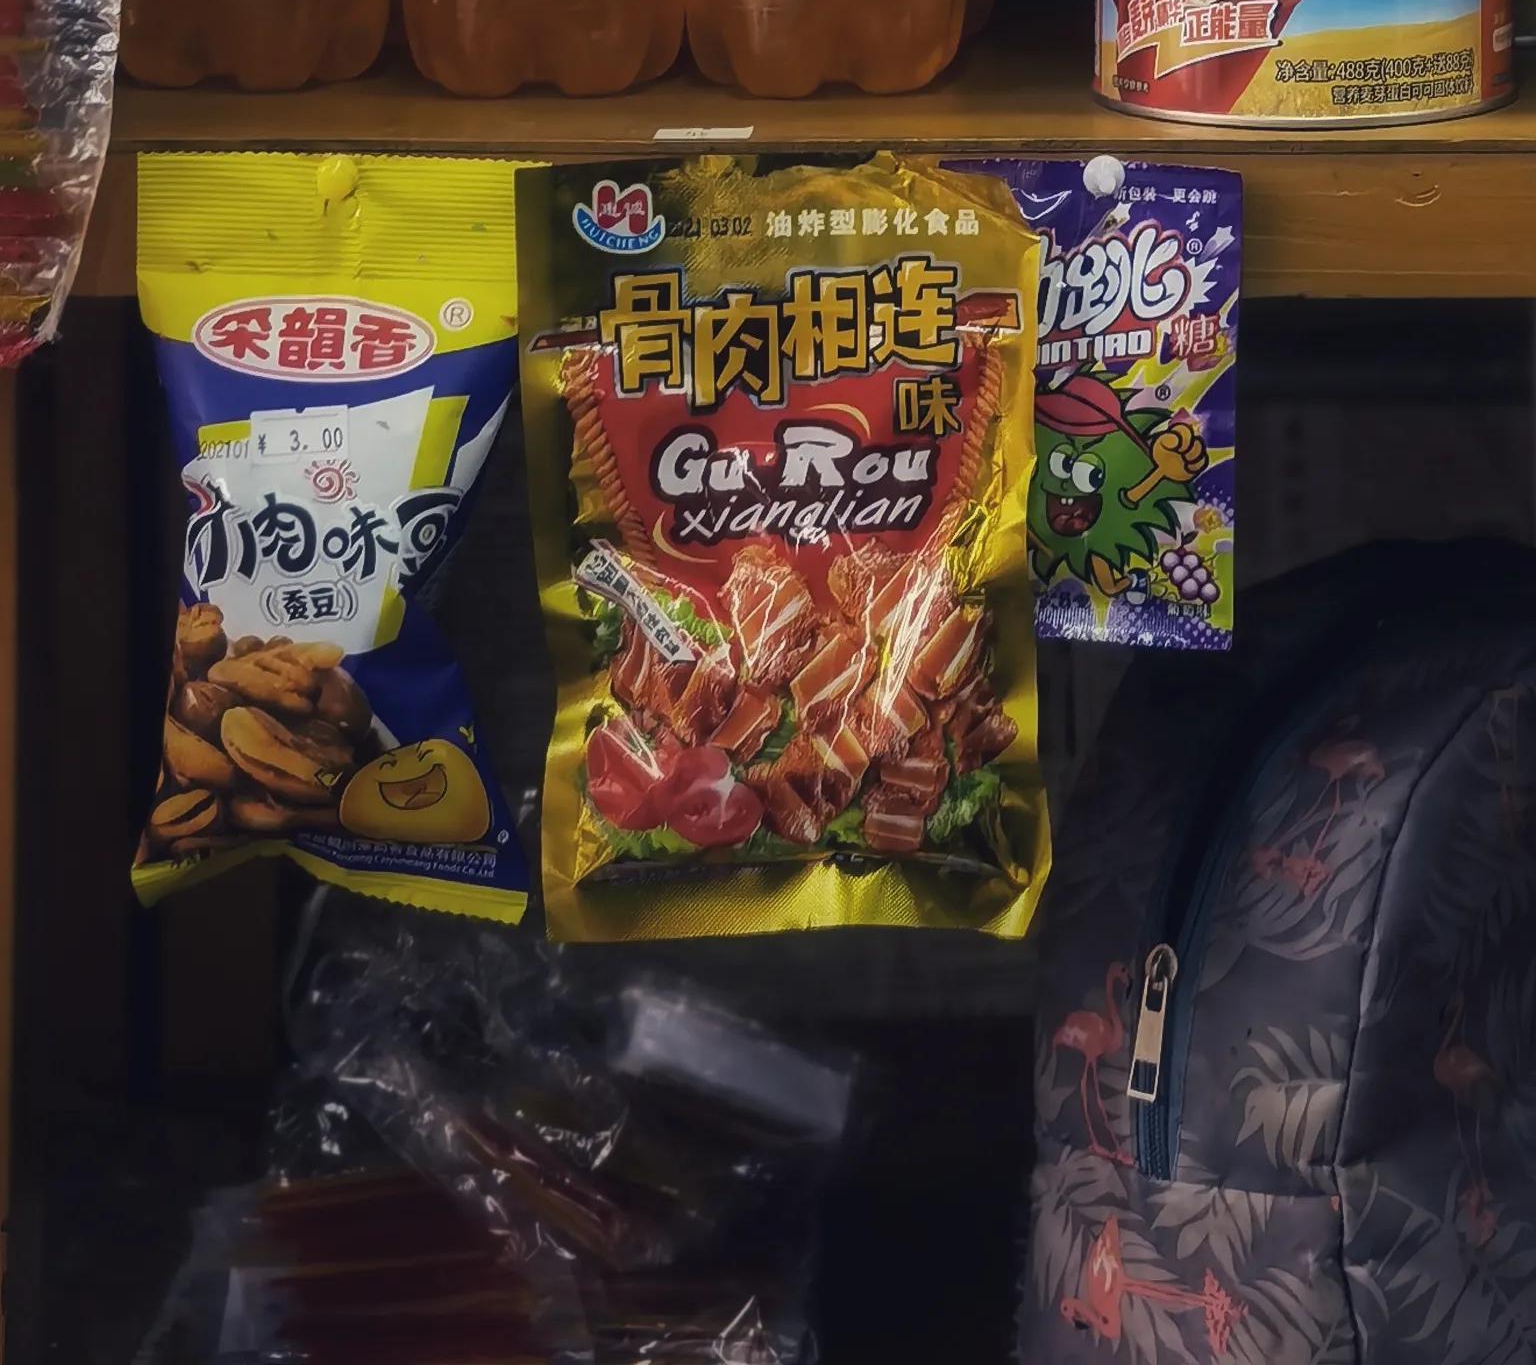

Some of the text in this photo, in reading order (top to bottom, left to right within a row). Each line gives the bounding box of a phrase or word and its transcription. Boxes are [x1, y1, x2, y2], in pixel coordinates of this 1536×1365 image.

[1184, 1, 1273, 44] 正能量
[765, 209, 979, 237] 油炸型膨化食品
[602, 262, 963, 405] 骨肉相连
[1172, 316, 1217, 358] 糖
[897, 378, 963, 435] 味
[289, 426, 343, 453] 3.00
[782, 425, 930, 490] Rou
[680, 483, 924, 544] xianglian
[264, 586, 358, 624] (蚕豆)
